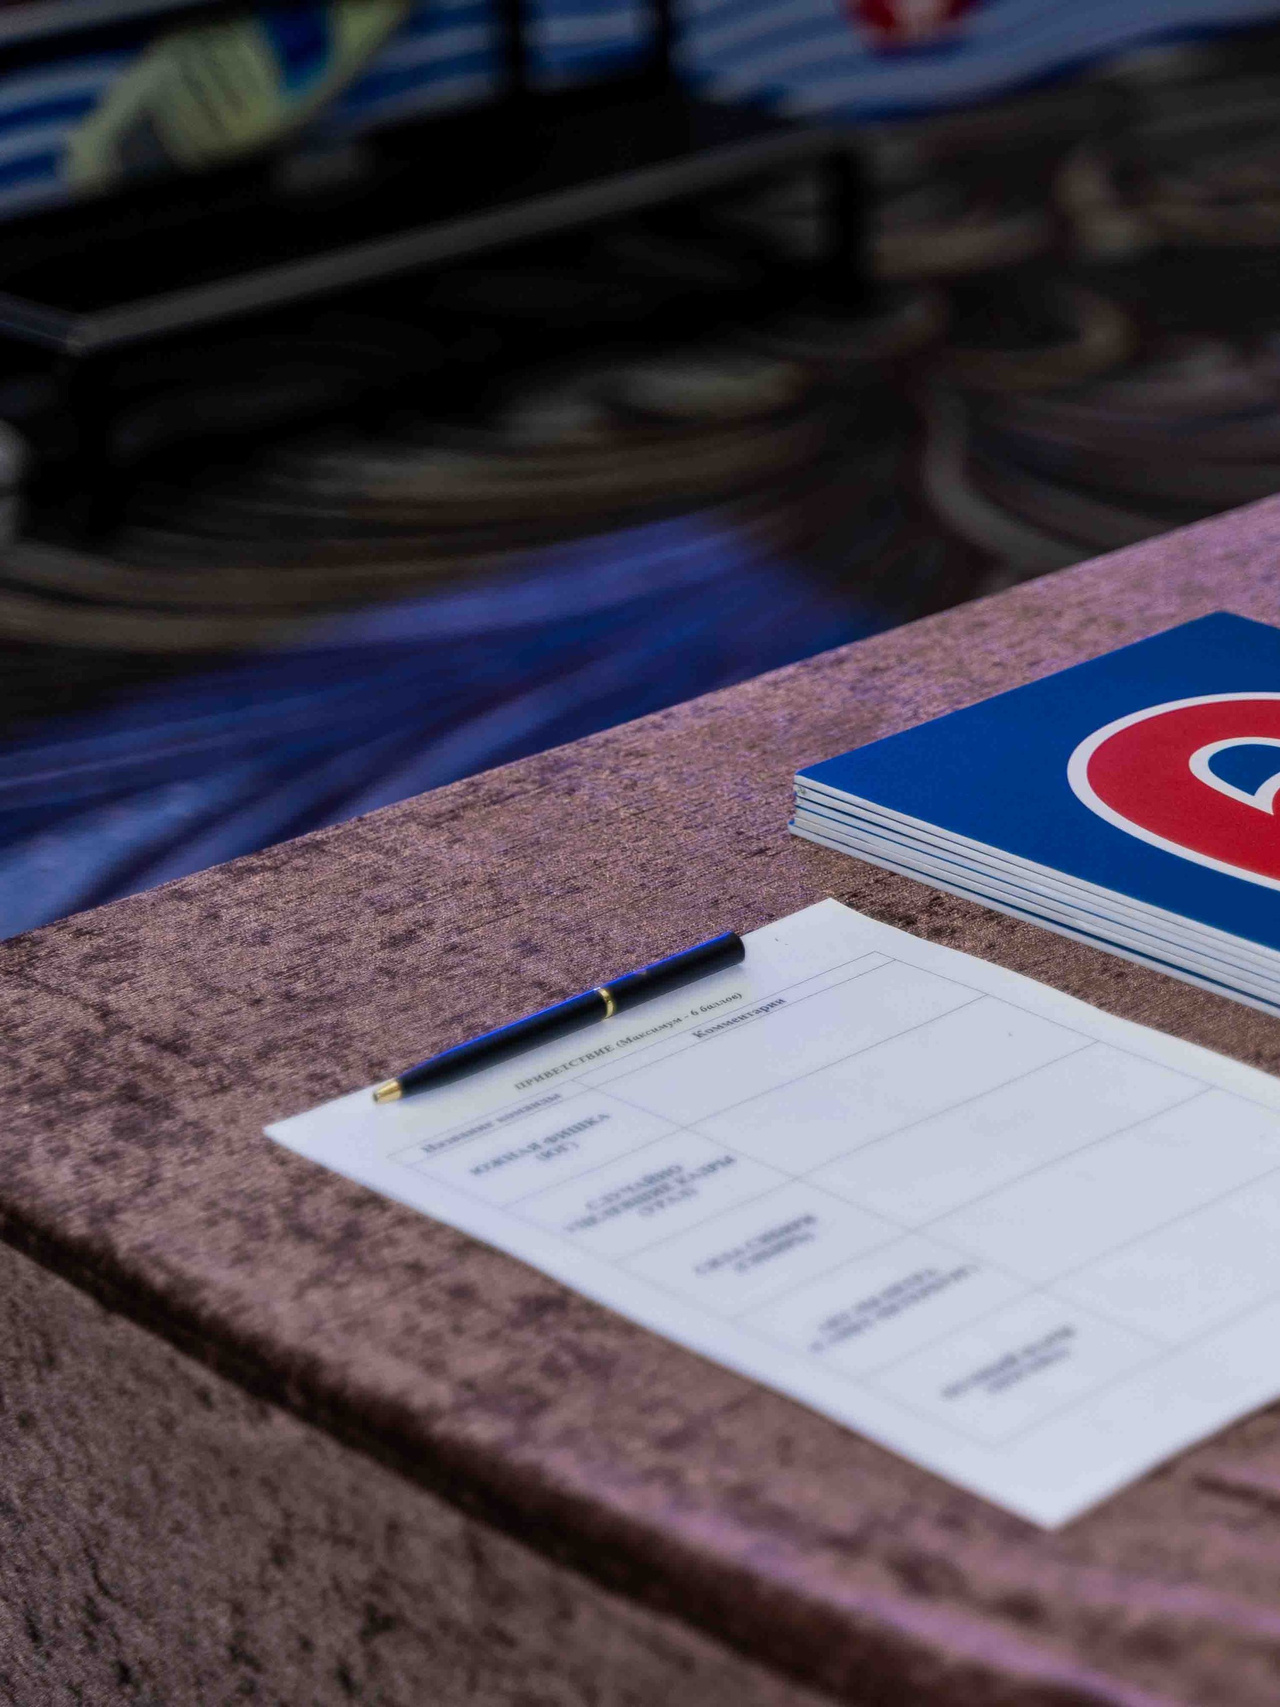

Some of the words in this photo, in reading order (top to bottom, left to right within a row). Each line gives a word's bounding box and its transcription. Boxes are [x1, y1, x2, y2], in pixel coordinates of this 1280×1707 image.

[515, 1044, 616, 1091] ПРИВЕТСТВИЕ
[615, 1016, 683, 1049] (Максимум
[690, 1009, 699, 1018] 6
[699, 991, 743, 1015] баллов)
[691, 996, 787, 1041] Комментарии
